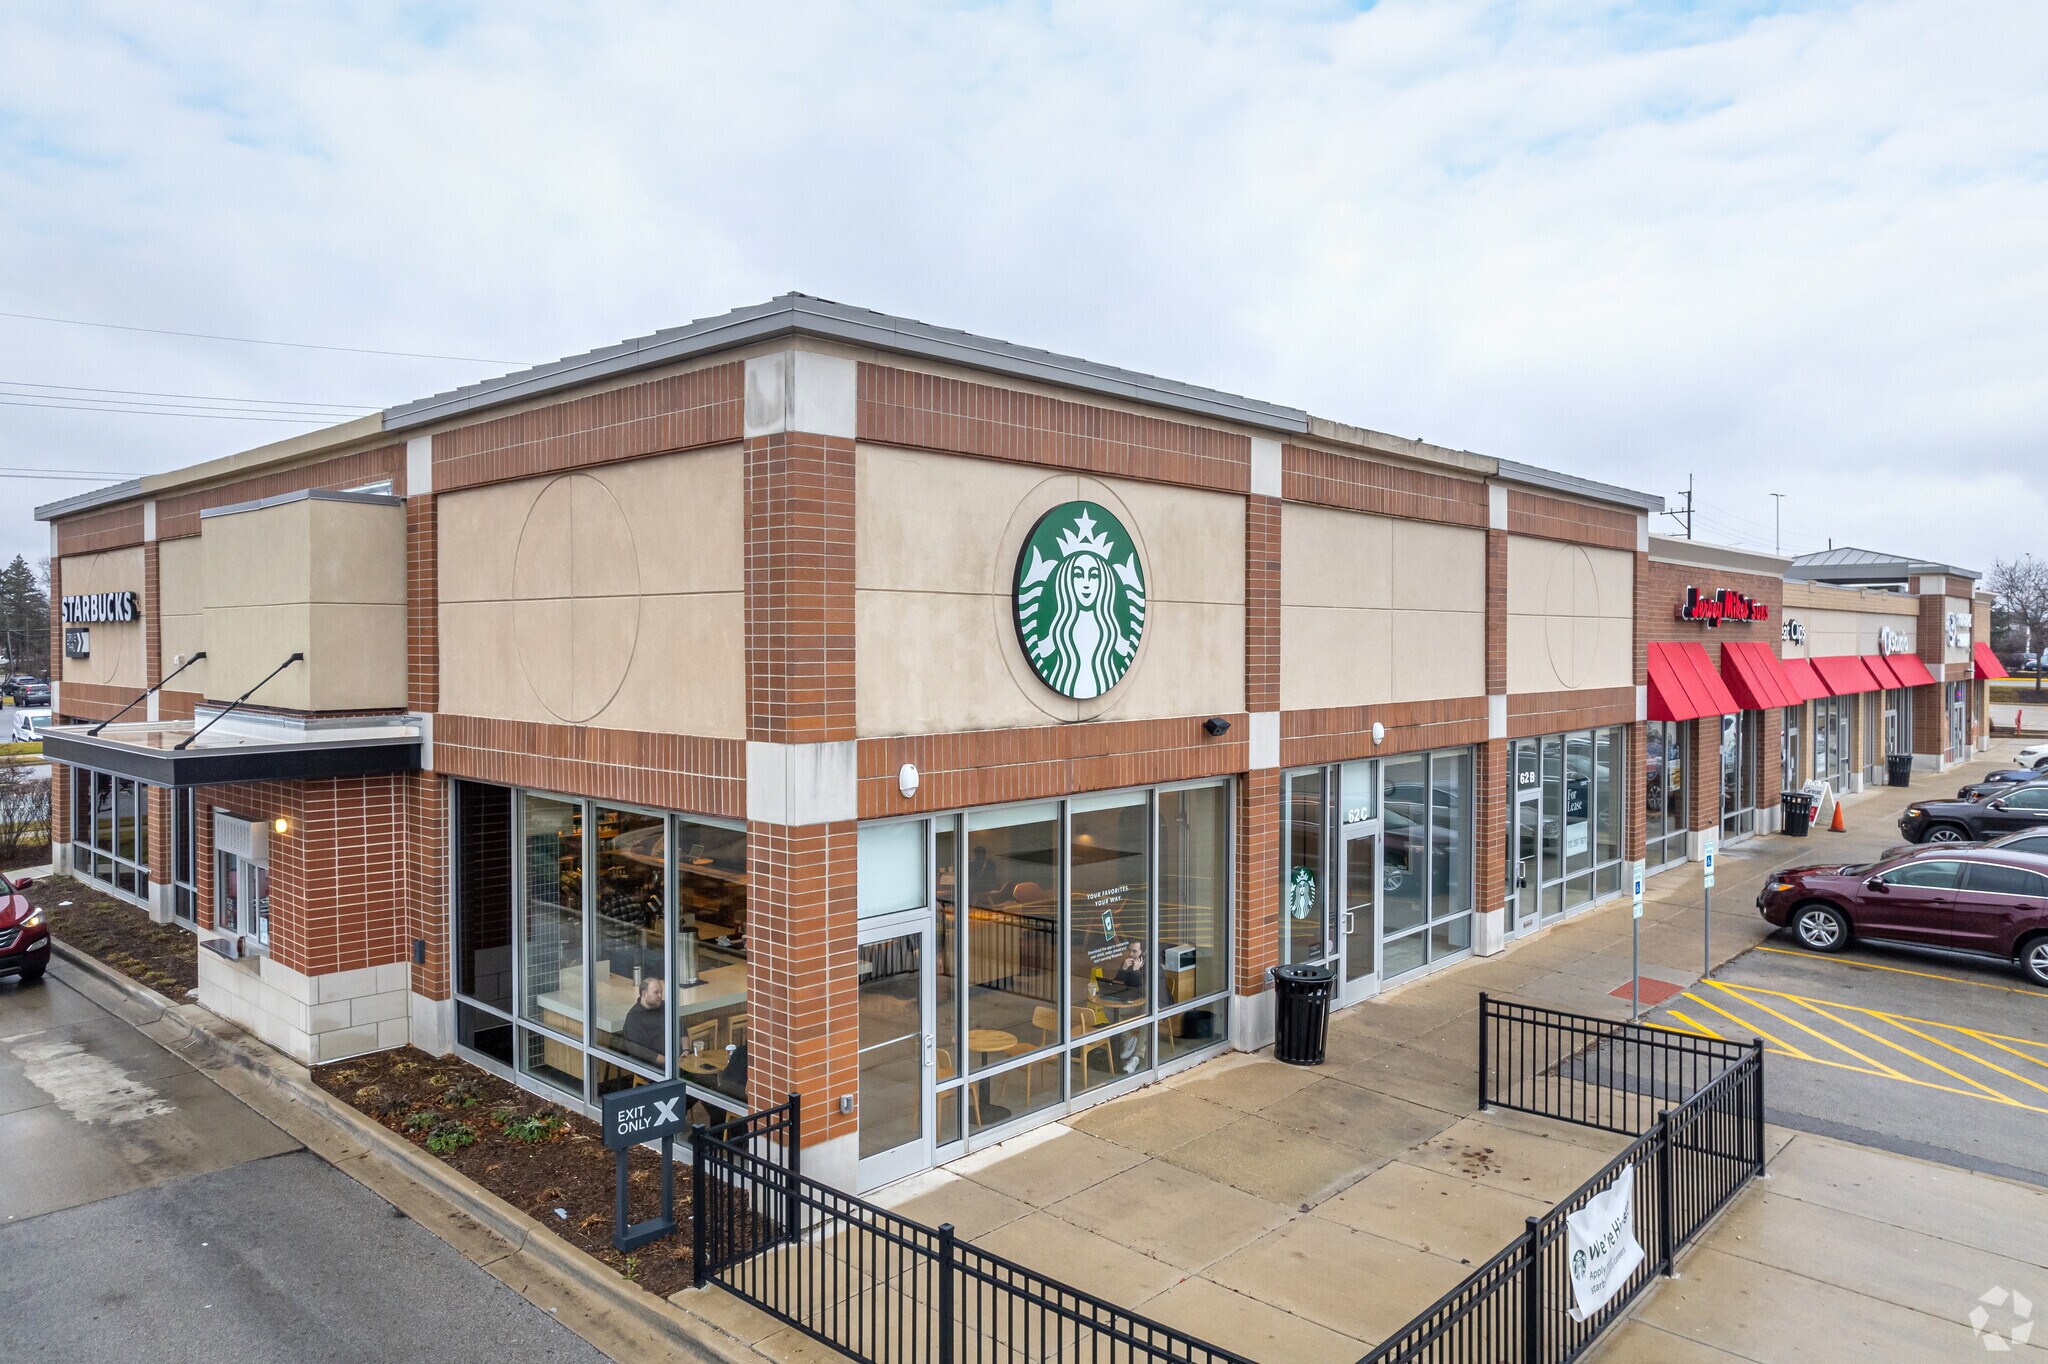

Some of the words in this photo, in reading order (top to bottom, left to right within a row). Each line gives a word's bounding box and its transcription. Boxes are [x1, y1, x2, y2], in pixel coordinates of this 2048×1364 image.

[62, 592, 132, 622] STARBUCKS
[1520, 771, 1535, 785] 62B
[1567, 788, 1577, 801] For
[1804, 787, 1821, 795] Great
[1567, 800, 1583, 813] Lease
[1348, 806, 1368, 822] 62C
[1087, 892, 1100, 900] YOUR
[1095, 898, 1109, 907] YOUR
[618, 1105, 645, 1122] EXIT
[618, 1116, 652, 1134] ONLY
[1589, 1264, 1607, 1281] Apply
